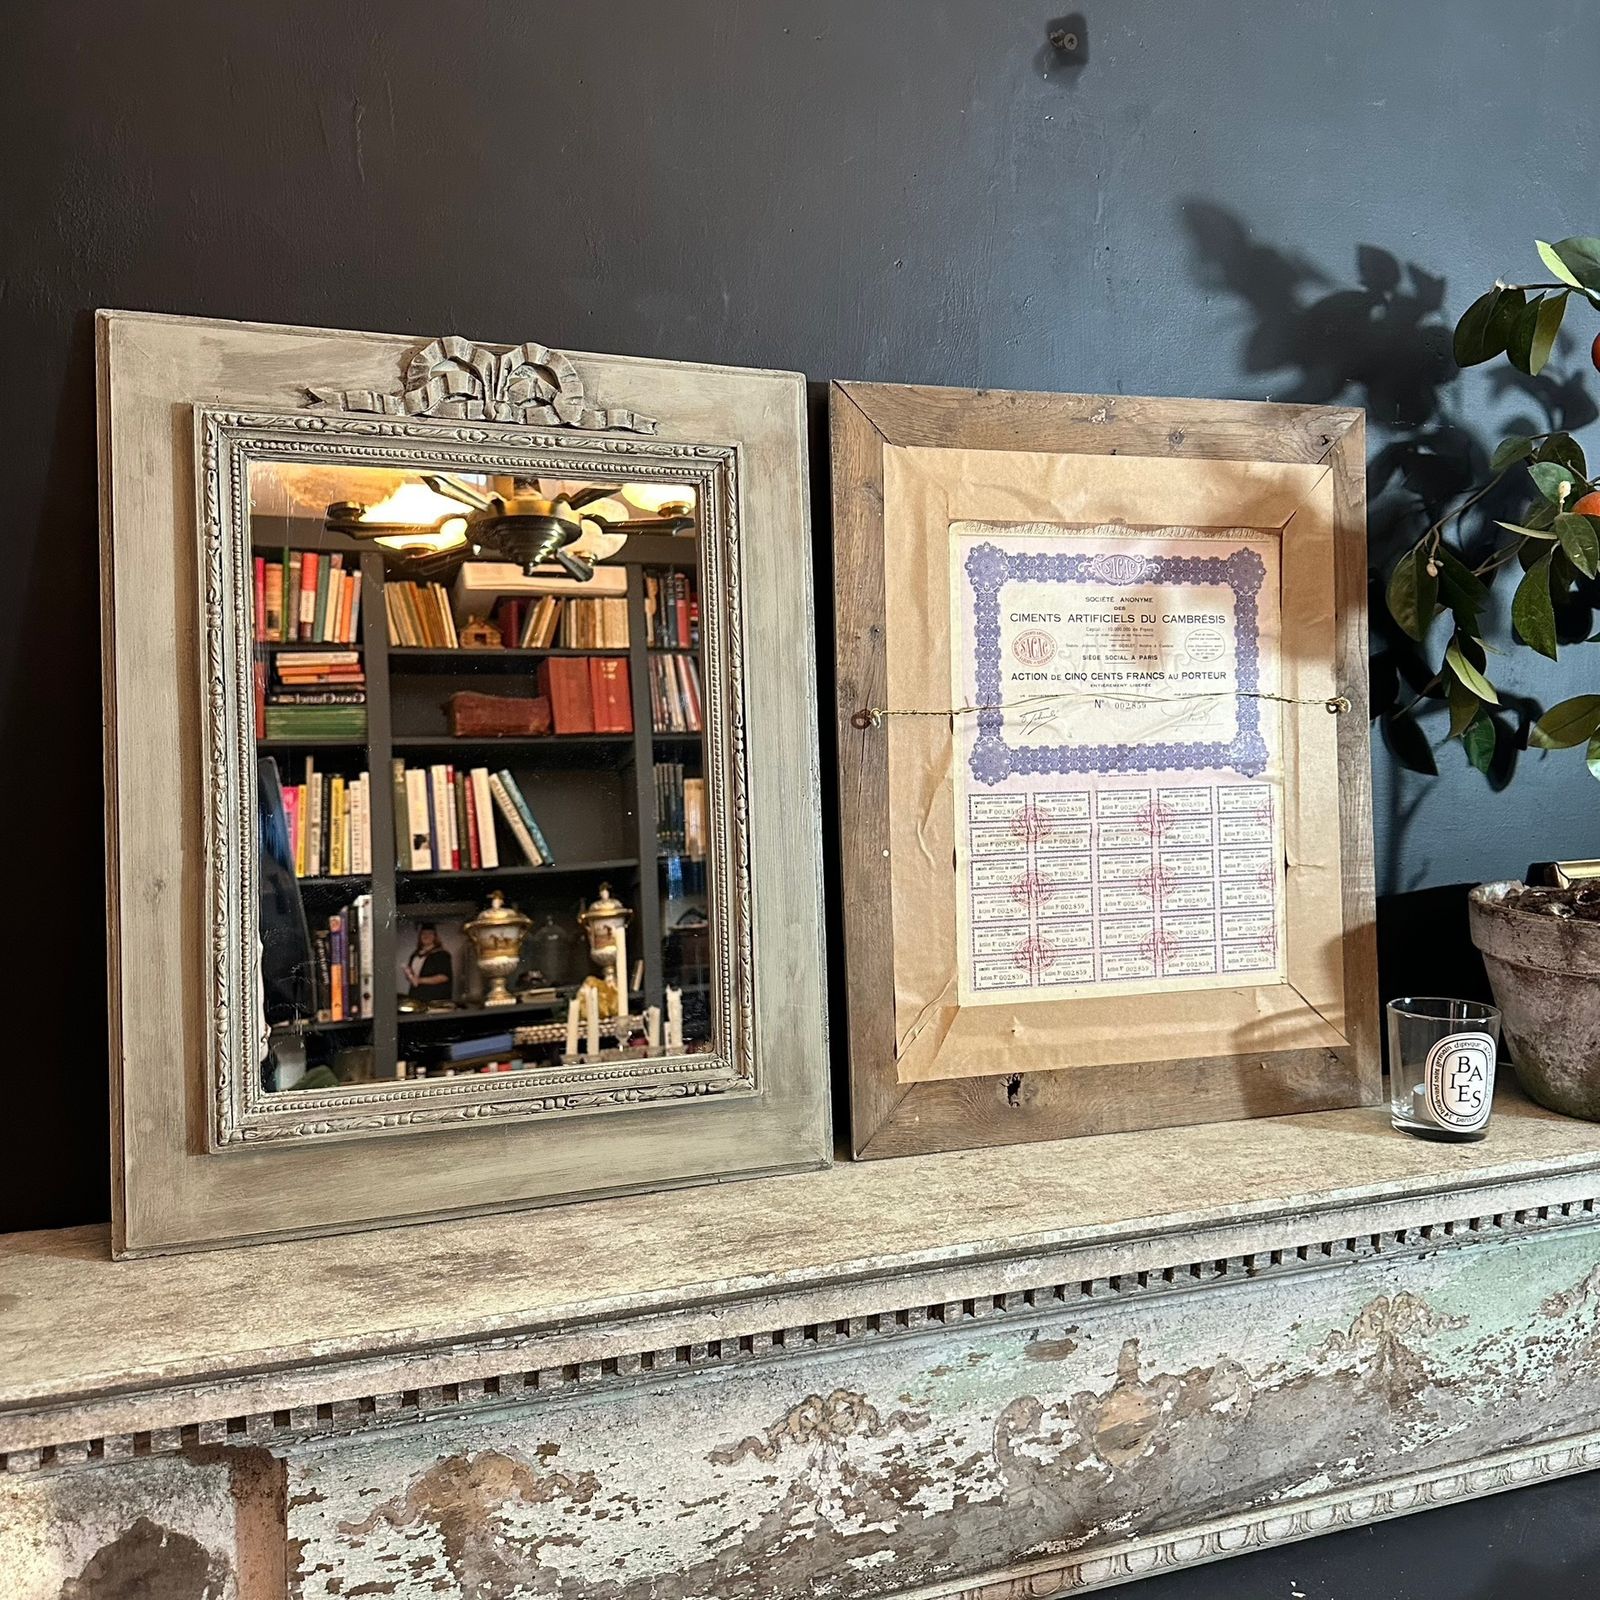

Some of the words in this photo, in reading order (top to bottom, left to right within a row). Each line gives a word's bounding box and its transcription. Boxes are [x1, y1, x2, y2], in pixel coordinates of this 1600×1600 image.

[1010, 613, 1061, 623] CIMENTS
[1067, 613, 1135, 623] ARTIFICIELS
[1141, 614, 1157, 623] DU
[1162, 614, 1226, 624] CAMBRÉSIS
[1011, 672, 1048, 681] ACTION
[1064, 672, 1088, 682] CINQ
[1091, 672, 1124, 680] CENTS
[1126, 672, 1165, 680] FRANCS
[1182, 671, 1227, 680] PORTEUR
